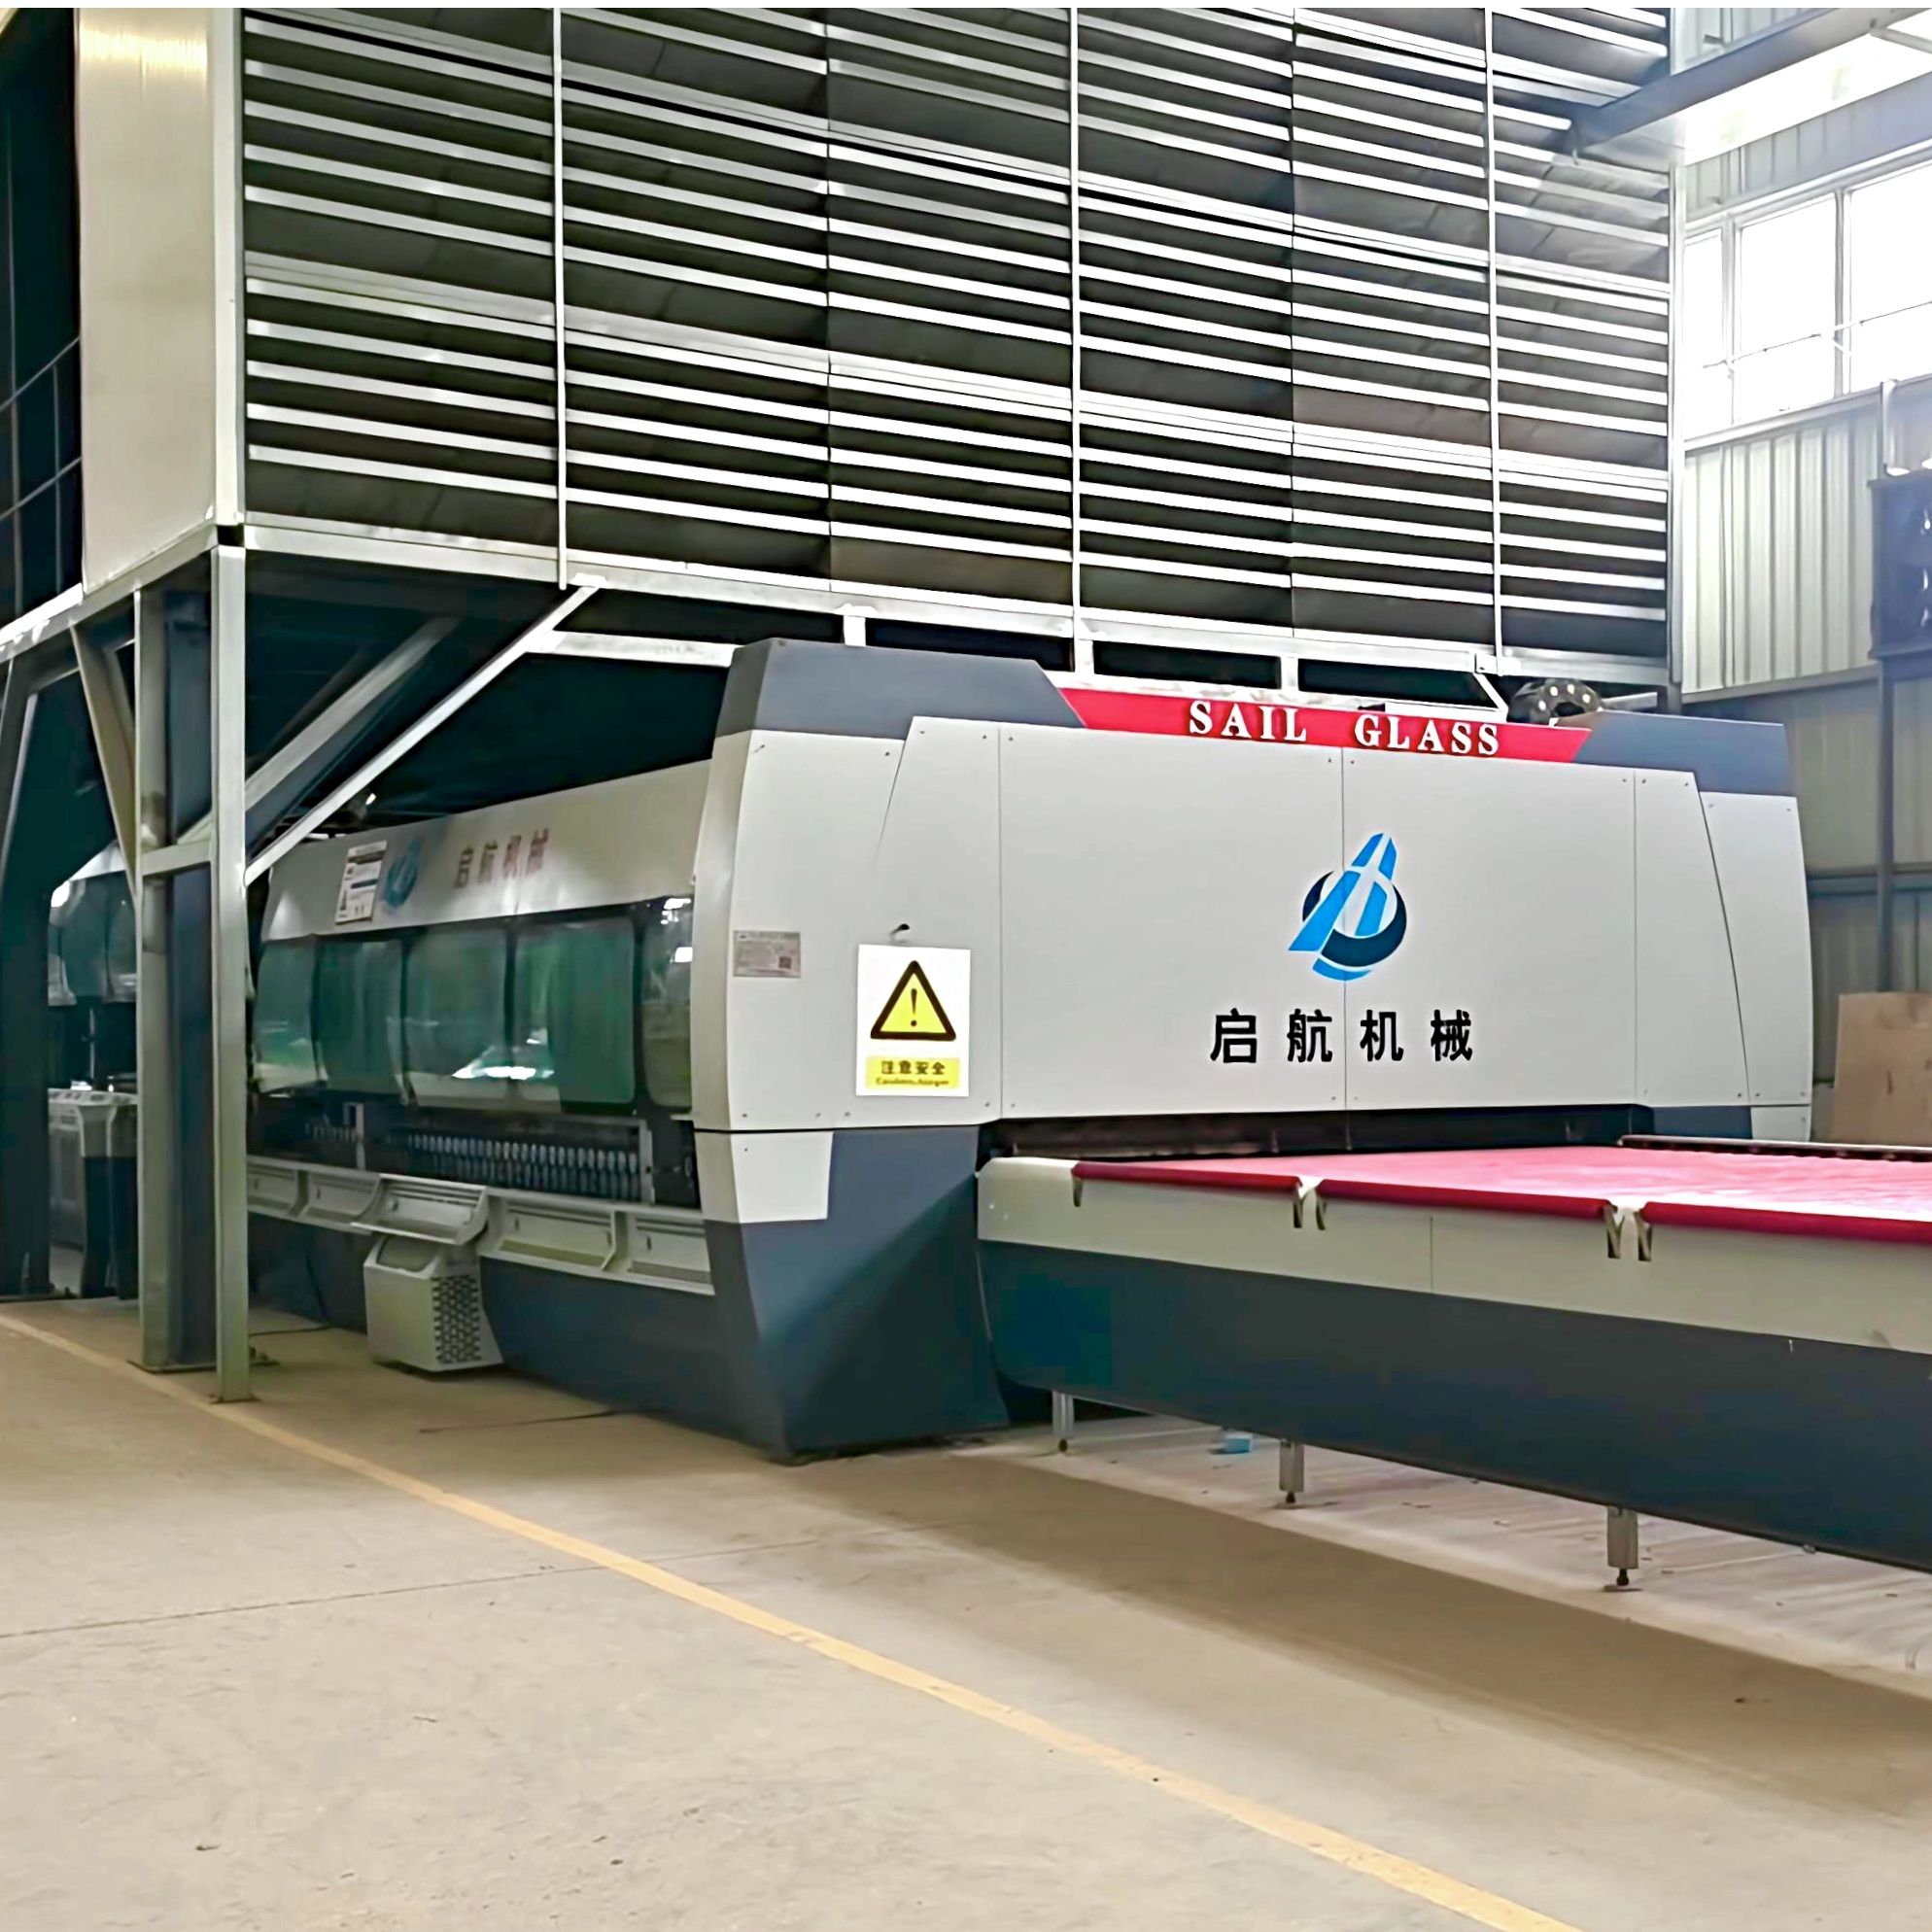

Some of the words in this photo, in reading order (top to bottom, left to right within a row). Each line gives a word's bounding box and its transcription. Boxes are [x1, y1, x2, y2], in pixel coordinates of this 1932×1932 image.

[1189, 700, 1307, 742] SAIL
[1354, 713, 1500, 756] GLASS
[1210, 1007, 1473, 1064] 启航机械
